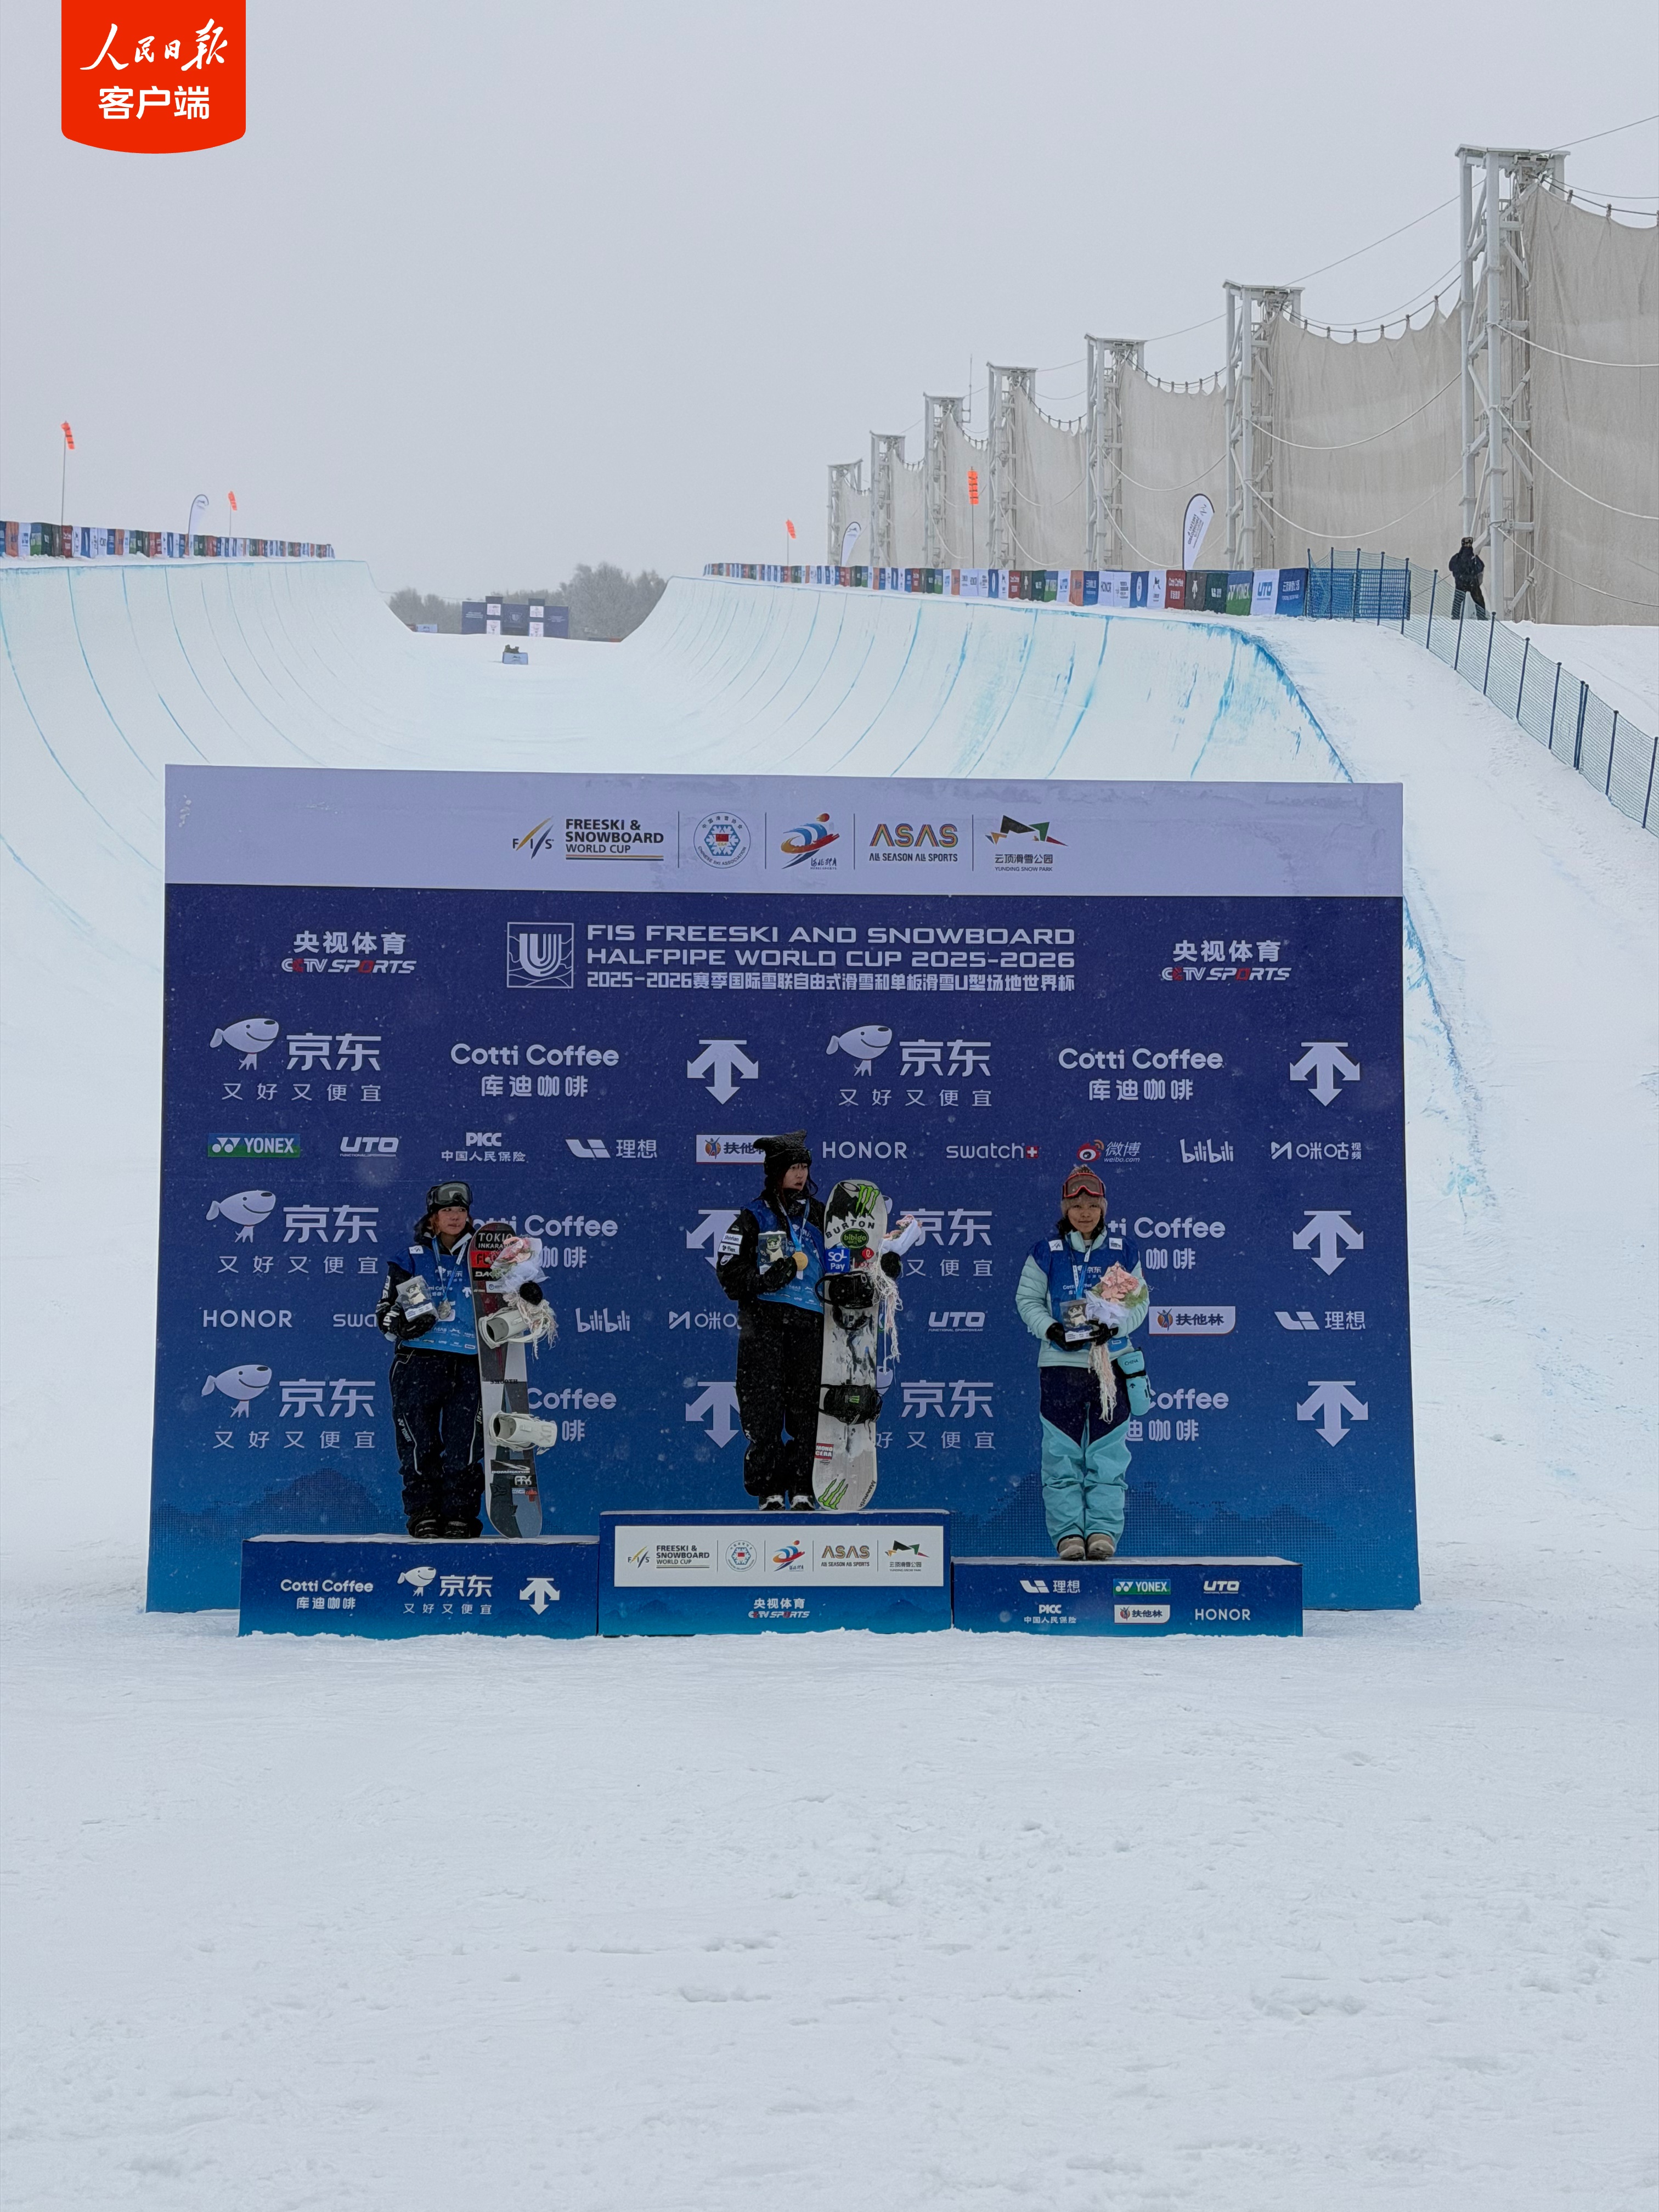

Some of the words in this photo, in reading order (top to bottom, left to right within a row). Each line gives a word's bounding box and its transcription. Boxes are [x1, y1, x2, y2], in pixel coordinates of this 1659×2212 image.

[1235, 583, 1250, 601] YONEX
[1257, 582, 1272, 597] UTO
[566, 819, 625, 830] FREESKI
[630, 819, 641, 831] &
[565, 831, 664, 844] SNOWBOARD
[870, 823, 958, 848] ASAS
[566, 844, 606, 853] WORLD
[610, 845, 631, 854] CUP
[721, 847, 747, 866] ASSOCIATION
[882, 853, 913, 862] SEASON
[928, 853, 958, 862] SPORTS
[995, 854, 1053, 865] 云顶滑雪公园
[293, 930, 407, 955] 央视体育
[588, 924, 634, 941] FIS
[646, 925, 778, 943] FREESKI
[789, 927, 856, 944] AND
[867, 927, 1075, 945] SNOWBOARD
[588, 948, 726, 965] HALFPIPE
[735, 950, 836, 967] WORLD
[846, 950, 902, 967] CUP
[911, 951, 1075, 968] 2025-2026
[1172, 940, 1281, 963] 央视体育
[328, 958, 417, 974] SPORTS
[1206, 967, 1292, 981] SPORTS
[286, 1032, 382, 1071] 京东
[450, 1043, 518, 1065] Cotti
[526, 1044, 619, 1066] Coffee
[899, 1039, 991, 1077] 京东
[1058, 1048, 1125, 1069] Cotti
[1132, 1048, 1224, 1070] Coffee
[222, 1083, 382, 1102] 又好又便宜
[481, 1075, 588, 1097] 库迪咖啡
[1089, 1079, 1194, 1101] 库迪咖啡
[838, 1089, 992, 1107] 又好又便宜
[244, 1137, 294, 1153] YONEX
[340, 1137, 399, 1153] UTO
[466, 1132, 502, 1147] PICC
[441, 1150, 526, 1163] 中国人民保险
[616, 1139, 658, 1159] 理想
[822, 1141, 908, 1159] HONOR
[946, 1142, 1024, 1159] swatch
[1105, 1141, 1142, 1157] 微博
[1180, 1138, 1234, 1163] bilibili
[283, 1204, 379, 1244] 京东
[524, 1215, 618, 1237] Coffee
[825, 1219, 875, 1239] BURTON
[900, 1208, 992, 1246] 京东
[1134, 1217, 1226, 1238] Coffee
[844, 1234, 867, 1243] bibigo
[218, 1256, 379, 1274] 又好又便宜
[540, 1246, 587, 1268] 咖啡
[1146, 1248, 1196, 1269] 咖啡
[830, 1262, 845, 1271] Pay
[906, 1259, 993, 1277] 又便宜
[202, 1310, 292, 1328] HONOR
[332, 1313, 377, 1328] swa
[575, 1307, 630, 1333] bilibili
[928, 1312, 985, 1327] UTO
[1175, 1313, 1224, 1327] 扶他林
[1324, 1311, 1366, 1330] 理想
[279, 1378, 376, 1418] 京东
[527, 1387, 617, 1409] Coffee
[900, 1379, 994, 1418] 京东
[1125, 1419, 1199, 1442] 迪咖啡
[213, 1431, 375, 1449] 又好又便宜
[876, 1431, 995, 1449] 好又便宜
[821, 1545, 870, 1559] ASAS
[280, 1579, 318, 1592] Cotti
[321, 1579, 374, 1593] Coffee
[439, 1574, 493, 1598] 京东
[1053, 1579, 1080, 1594] 理想
[1136, 1581, 1167, 1593] YONEX
[1203, 1581, 1240, 1591] UTO
[296, 1596, 356, 1610] 库迪咖啡
[403, 1602, 493, 1615] 又好又便宜
[753, 1598, 805, 1610] 央视体育
[1039, 1604, 1062, 1614] PICC
[1024, 1616, 1076, 1624] 中国人民保险
[1131, 1609, 1163, 1618] 扶他林
[1195, 1609, 1251, 1621] HONOR
